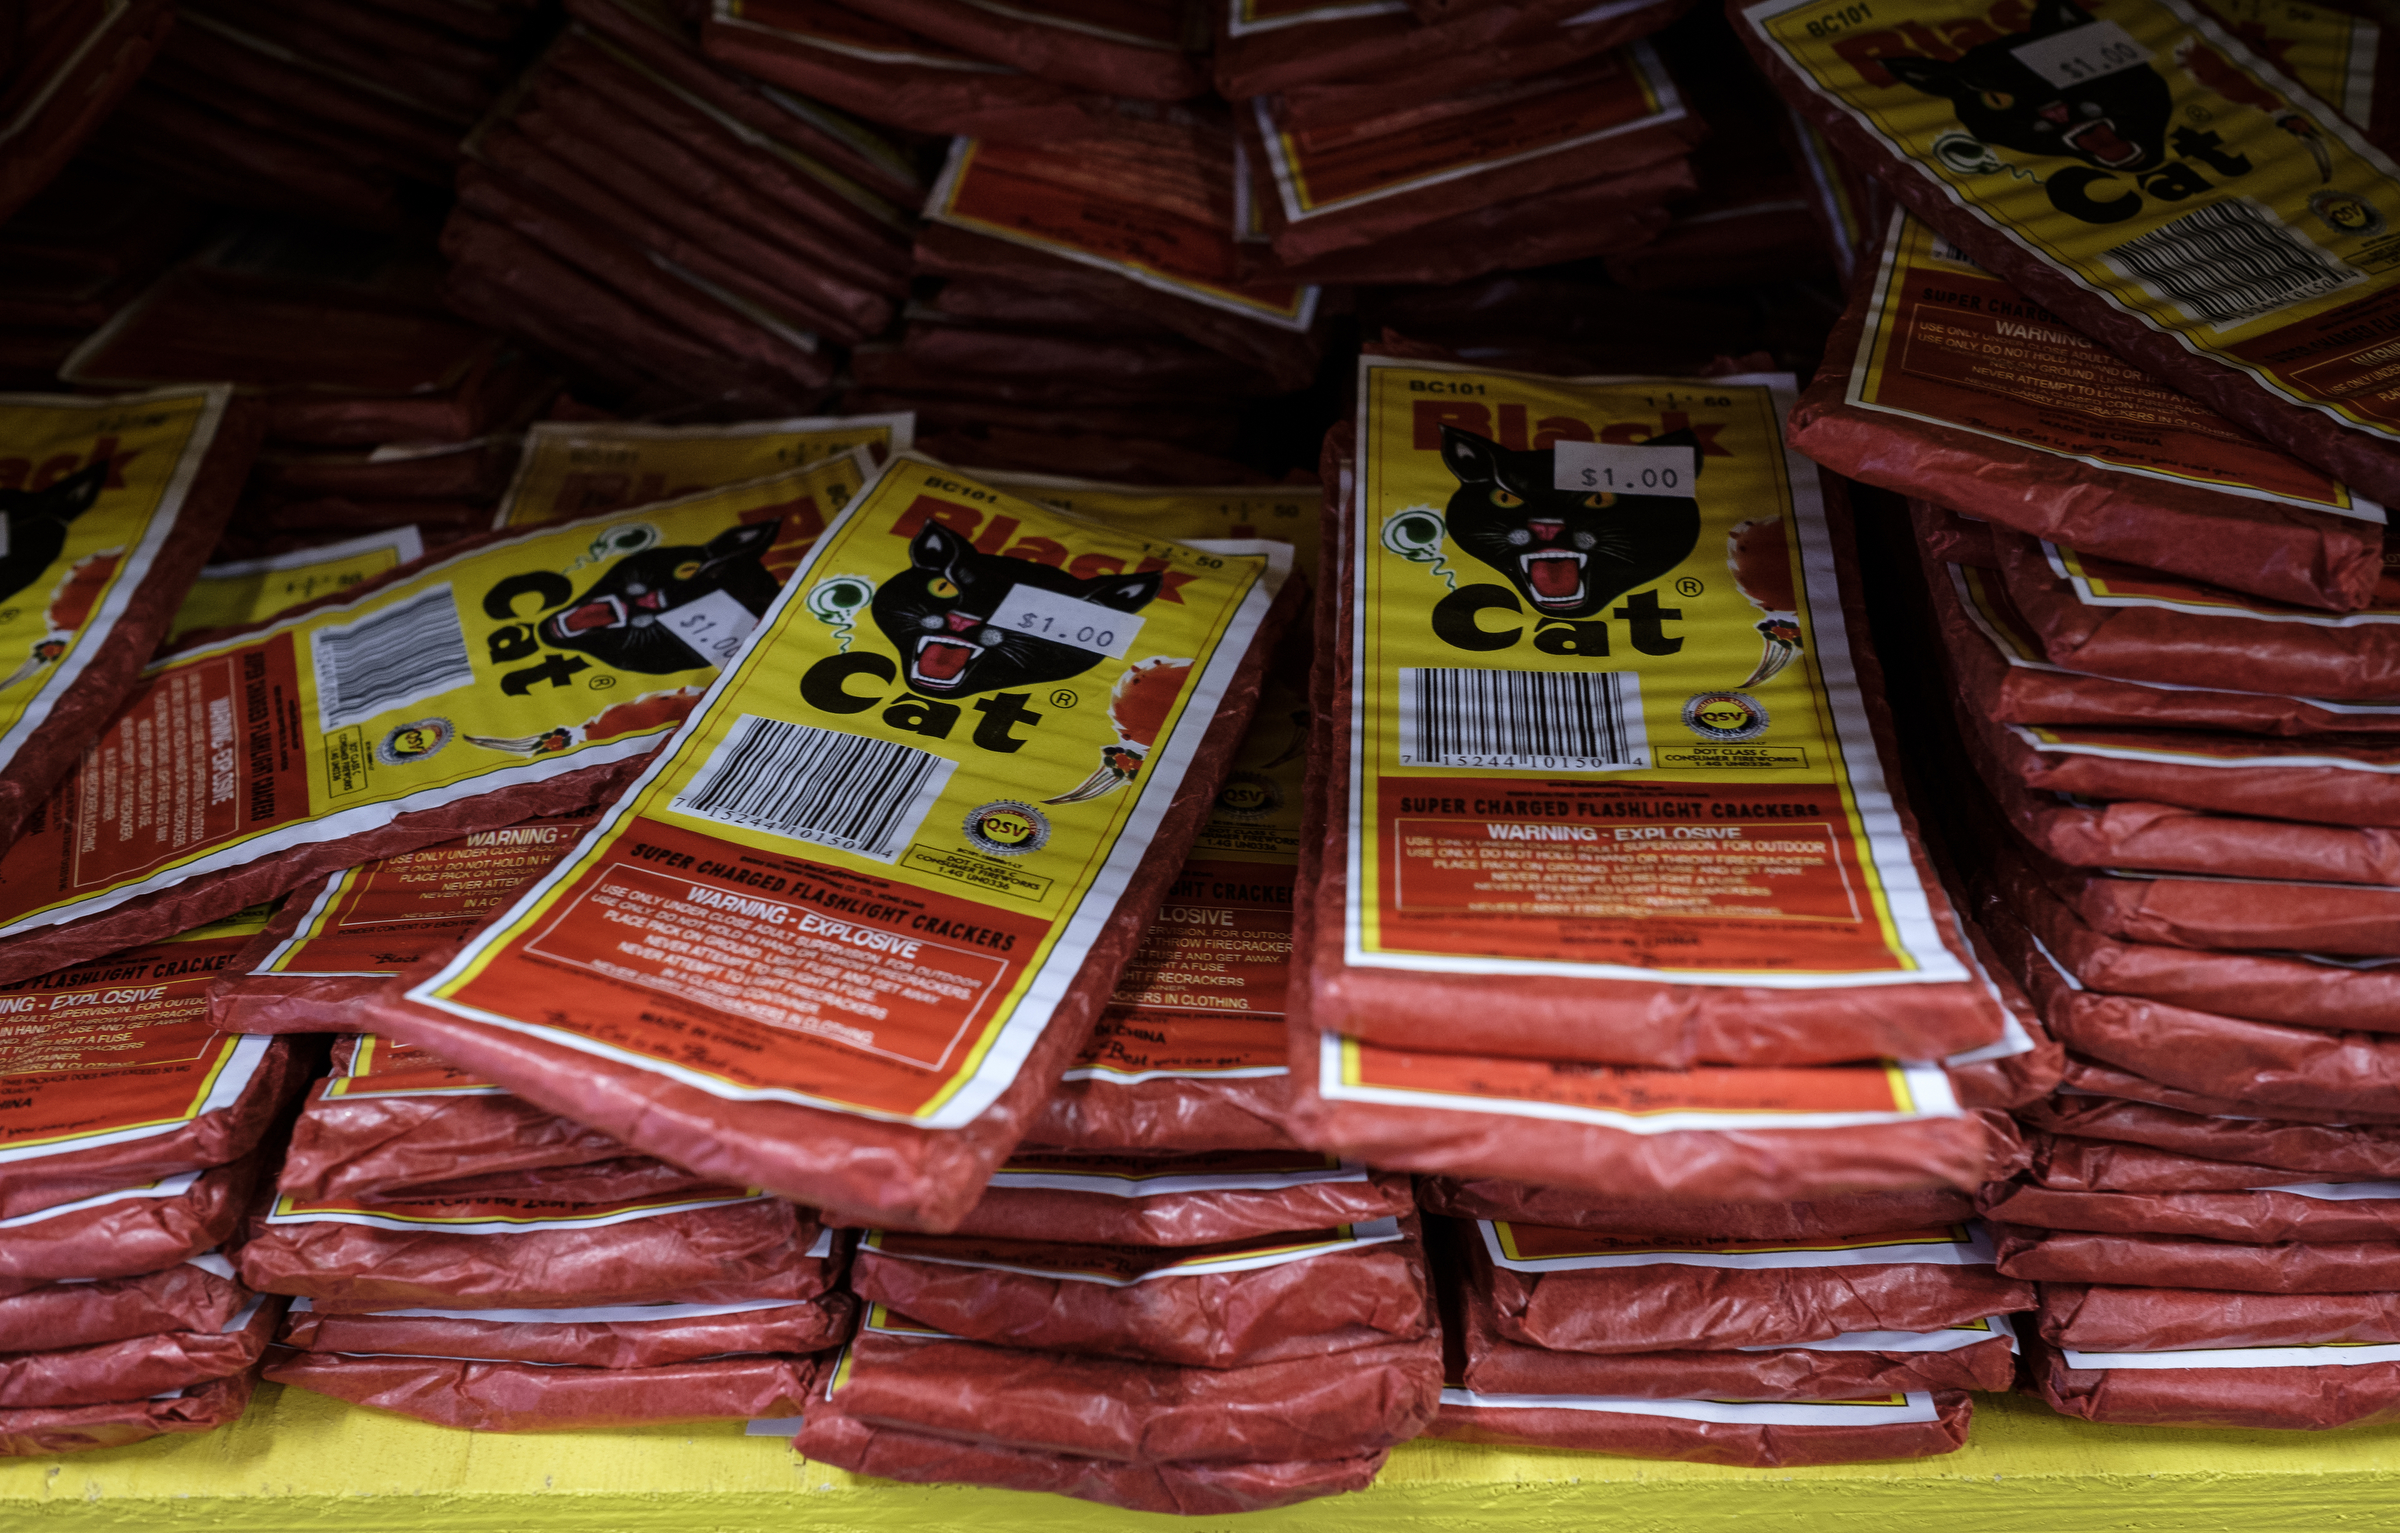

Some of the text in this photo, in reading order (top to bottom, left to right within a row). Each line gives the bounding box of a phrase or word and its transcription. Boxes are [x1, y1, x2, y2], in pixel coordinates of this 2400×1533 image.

[1806, 3, 1873, 40] BC101
[1834, 0, 2102, 88] Blac
[2061, 41, 2138, 80] $1.00
[2046, 126, 2252, 224] Cat
[1921, 286, 1982, 310] SUPER
[1918, 320, 1945, 334] USE
[1946, 326, 1982, 341] ONLY
[2070, 349, 2110, 364] ADULT
[1993, 320, 2094, 351] WARNING
[1916, 332, 2143, 381] USE ONLY. DO NOT HOLD OR
[1970, 364, 2095, 397] NEVER ATTEMPT TO
[2038, 362, 2098, 383] GROUND.
[1409, 380, 1486, 395] BC101
[1413, 399, 1737, 458] Black
[0, 437, 146, 492] ack
[1580, 465, 1679, 491] $1.00
[919, 476, 1226, 571] BC101 50
[889, 494, 1200, 606] Black
[1016, 611, 1115, 648] $1.00
[1432, 583, 1686, 657] Cat
[482, 570, 596, 698] Cat
[800, 650, 1043, 754] Cat
[1701, 711, 1744, 722] QSV
[206, 694, 236, 806] WARNING EXPLOSIVE
[1665, 753, 1798, 764] CONSUMER FIREWORKS
[1694, 747, 1717, 755] DOT
[1722, 748, 1755, 756] CLASS
[247, 721, 274, 823] FLASHLIGHT CRACKERS
[1401, 754, 1643, 770] 7 15244 10150 4
[1222, 788, 1262, 802] QSV
[1401, 797, 1821, 821] SUPER CHARGED FLASHLIGHT CRACKERS
[466, 828, 558, 848] WARNING
[670, 796, 895, 859] 7 15244 10150 4
[983, 817, 1027, 838] QSV
[1486, 823, 1742, 841] WARNING EXPLOSIVE
[388, 845, 529, 865] USE ONLY UNDER CLOSE
[1207, 838, 1276, 850] 1.4G UN0336
[1722, 840, 1827, 853] FOR OUTDOOR
[445, 862, 463, 870] DO
[465, 860, 492, 868] NOT
[494, 857, 524, 866] HOLD
[526, 855, 539, 865] IN
[914, 853, 975, 874] CONSUMER
[976, 868, 1041, 890] FIREWORKS
[945, 856, 969, 866] DOT
[971, 862, 1006, 875] CLASS
[398, 868, 491, 883] PLACE PACK ON
[441, 880, 482, 891] NEVER
[936, 866, 1011, 890] 1.4G UN0336
[462, 898, 488, 908] IN A
[628, 842, 696, 870] SUPER
[694, 859, 787, 892] CHARGED
[786, 881, 910, 925] FLASHLIGHT
[910, 913, 1016, 952] CRACKERS
[588, 893, 620, 907] USE
[653, 910, 679, 922] DO
[675, 915, 707, 930] NOT
[703, 923, 744, 940] HOLD
[597, 883, 629, 898] USE
[624, 890, 663, 907] ONLY
[659, 898, 711, 919] UNDER
[705, 911, 755, 930] CLOSE
[749, 922, 796, 942] ADULT
[882, 956, 916, 973] FOR
[601, 909, 706, 943] PLACE PACK ON
[683, 886, 923, 960] WARNING EXPLOSIVE
[1158, 907, 1233, 926] LOSIVE
[1155, 937, 1293, 953] THROW FIRECRACKER
[1214, 929, 1239, 938] FOR
[1149, 949, 1281, 963] FUSE AND GET AWAY.
[1179, 961, 1228, 972] A FUSE.
[32, 968, 147, 988] FLASHLIGHT
[1147, 970, 1245, 987] FIRECRACKERS
[48, 986, 167, 1009] EXPLOSIVE
[1165, 993, 1251, 1009] IN CLOTHING.
[5, 1001, 162, 1025] ADULT SUPERVISION. FOR
[15, 1022, 51, 1035] HAND
[99, 1032, 133, 1043] FUSE.
[1115, 1025, 1165, 1044] CHINA
